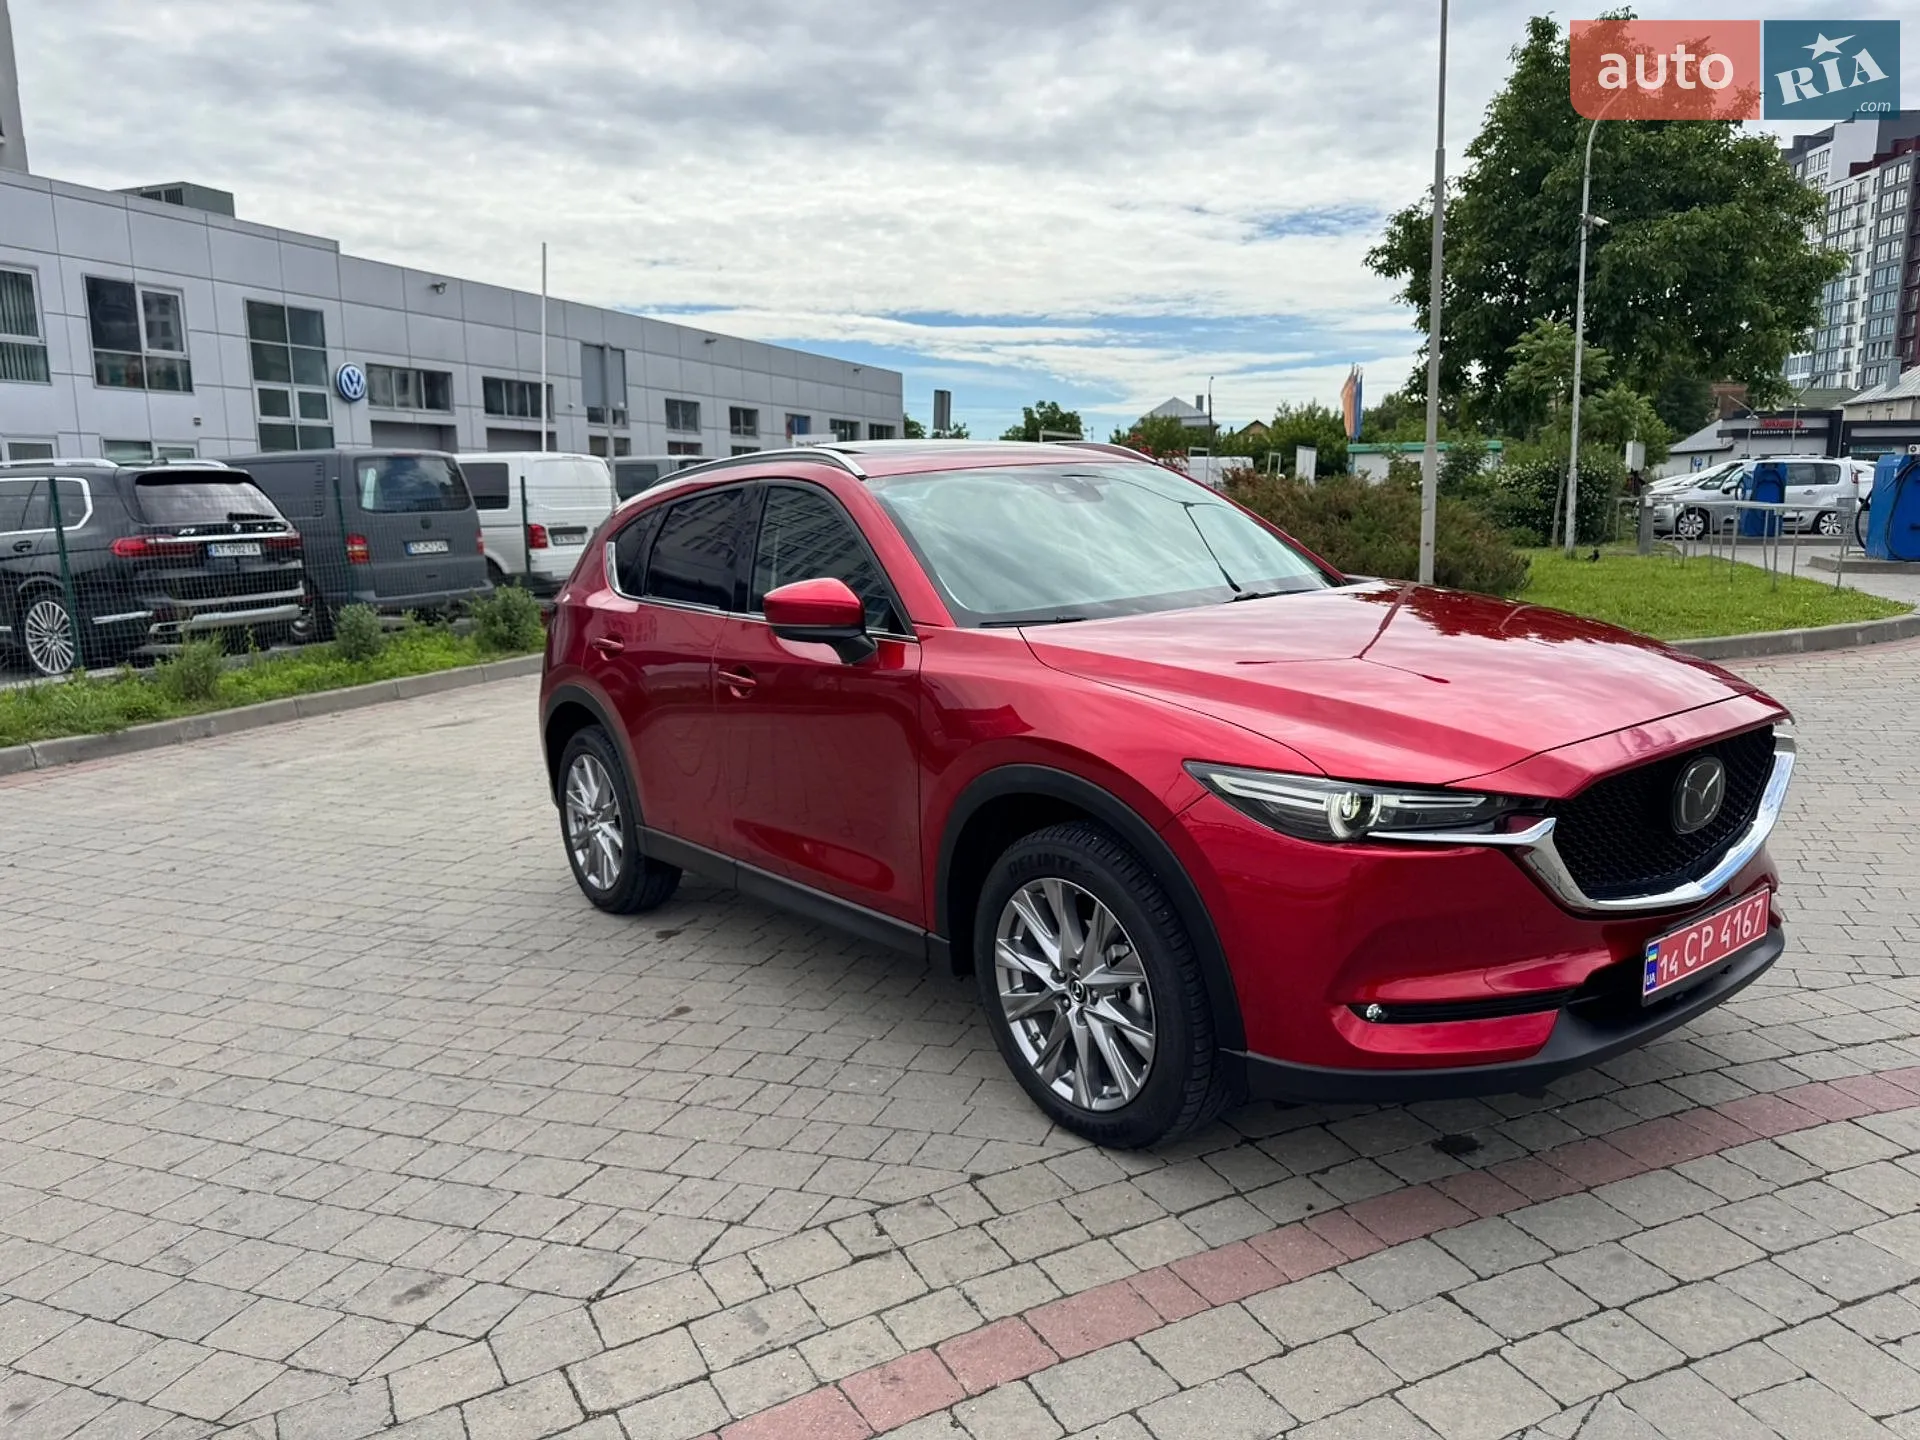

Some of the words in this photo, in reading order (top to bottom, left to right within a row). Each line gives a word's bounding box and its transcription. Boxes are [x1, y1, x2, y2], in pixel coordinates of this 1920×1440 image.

[1660, 949, 1679, 981] 14
[1684, 925, 1713, 967] CP
[1720, 898, 1764, 949] 4167
[1646, 973, 1656, 986] UA
